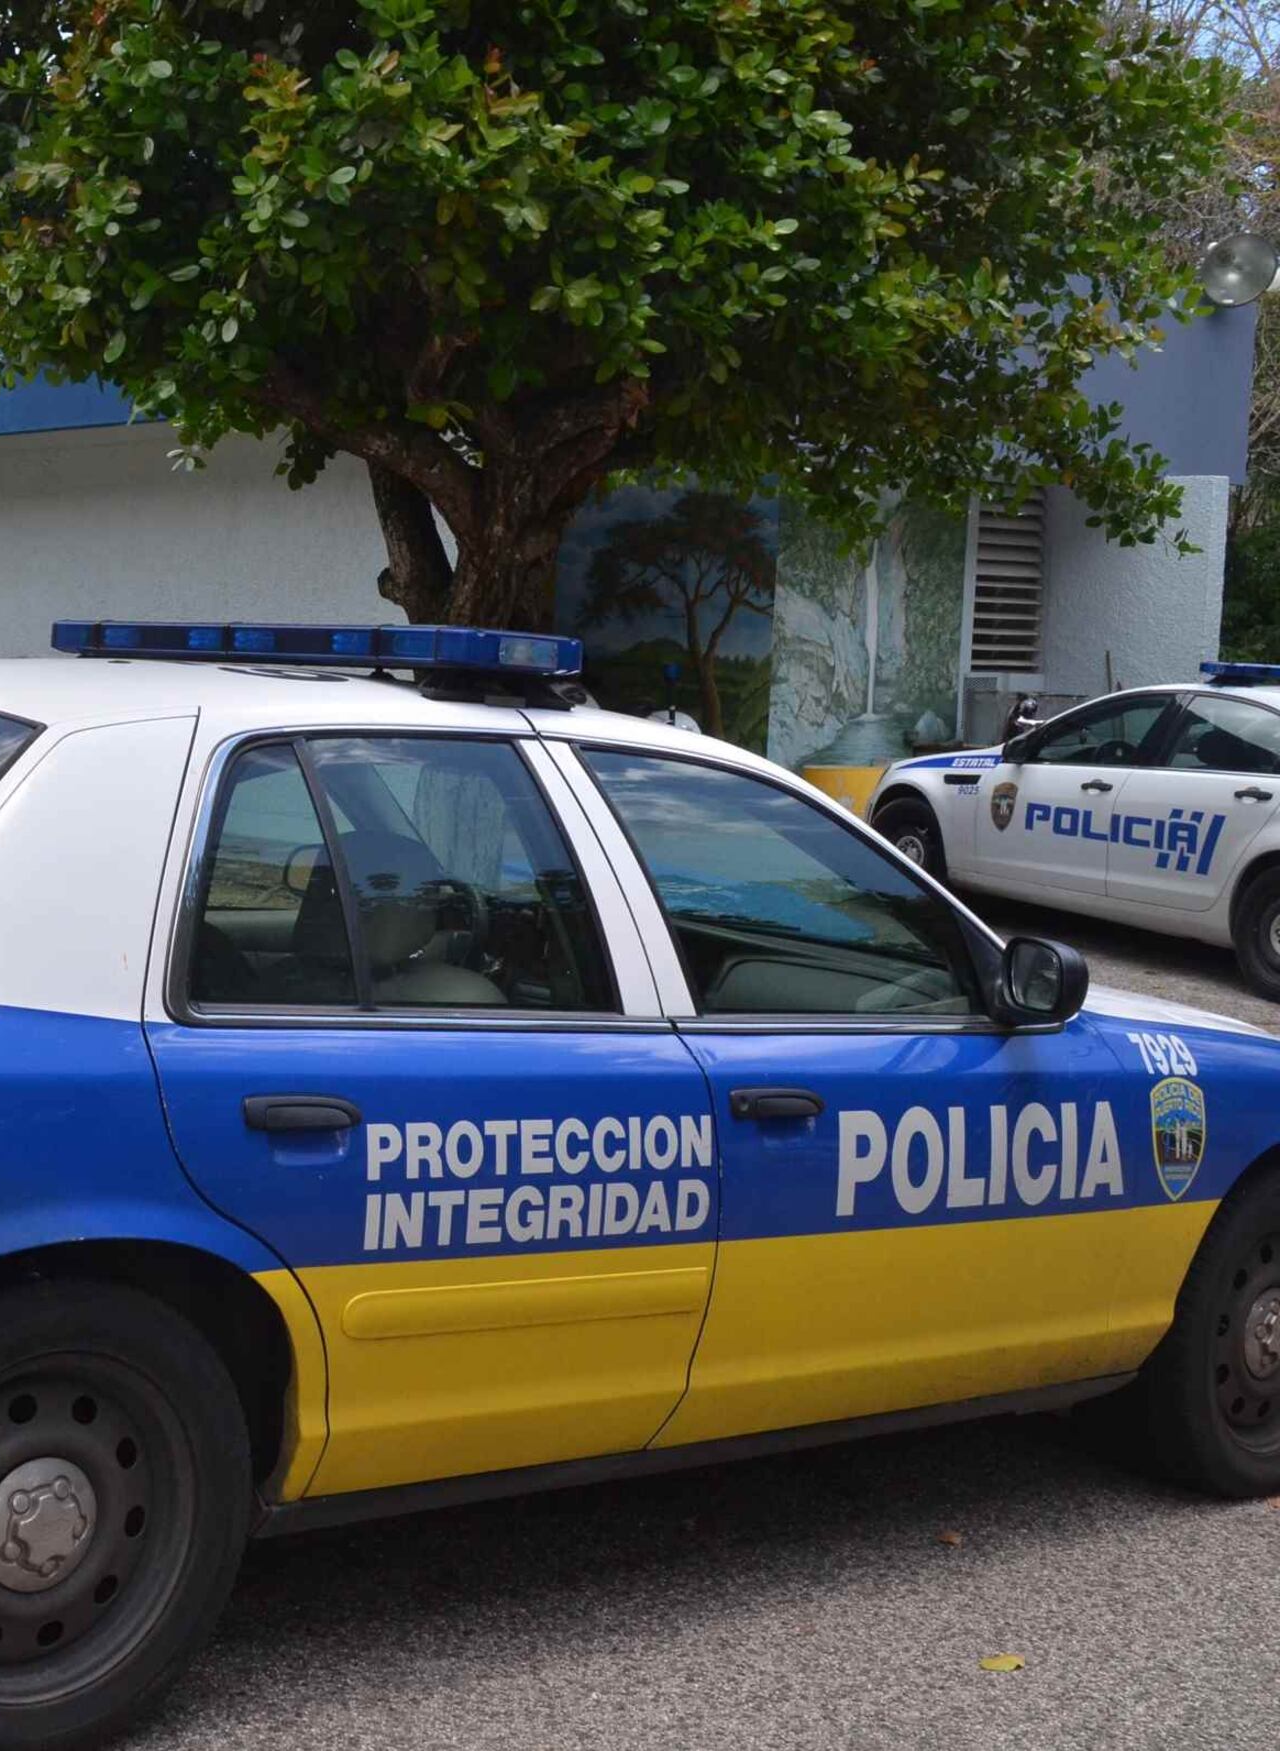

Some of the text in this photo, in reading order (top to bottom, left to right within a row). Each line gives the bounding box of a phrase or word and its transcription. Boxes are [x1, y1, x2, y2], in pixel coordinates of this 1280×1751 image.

[951, 757, 998, 768] ESTATAL
[958, 785, 981, 796] 9025
[1024, 802, 1199, 857] POLICIA
[1126, 1032, 1199, 1077] 7929
[365, 1114, 713, 1182] PROTECCION
[835, 1100, 1125, 1217] POLICIA
[363, 1178, 711, 1251] INTEGRIDAD
